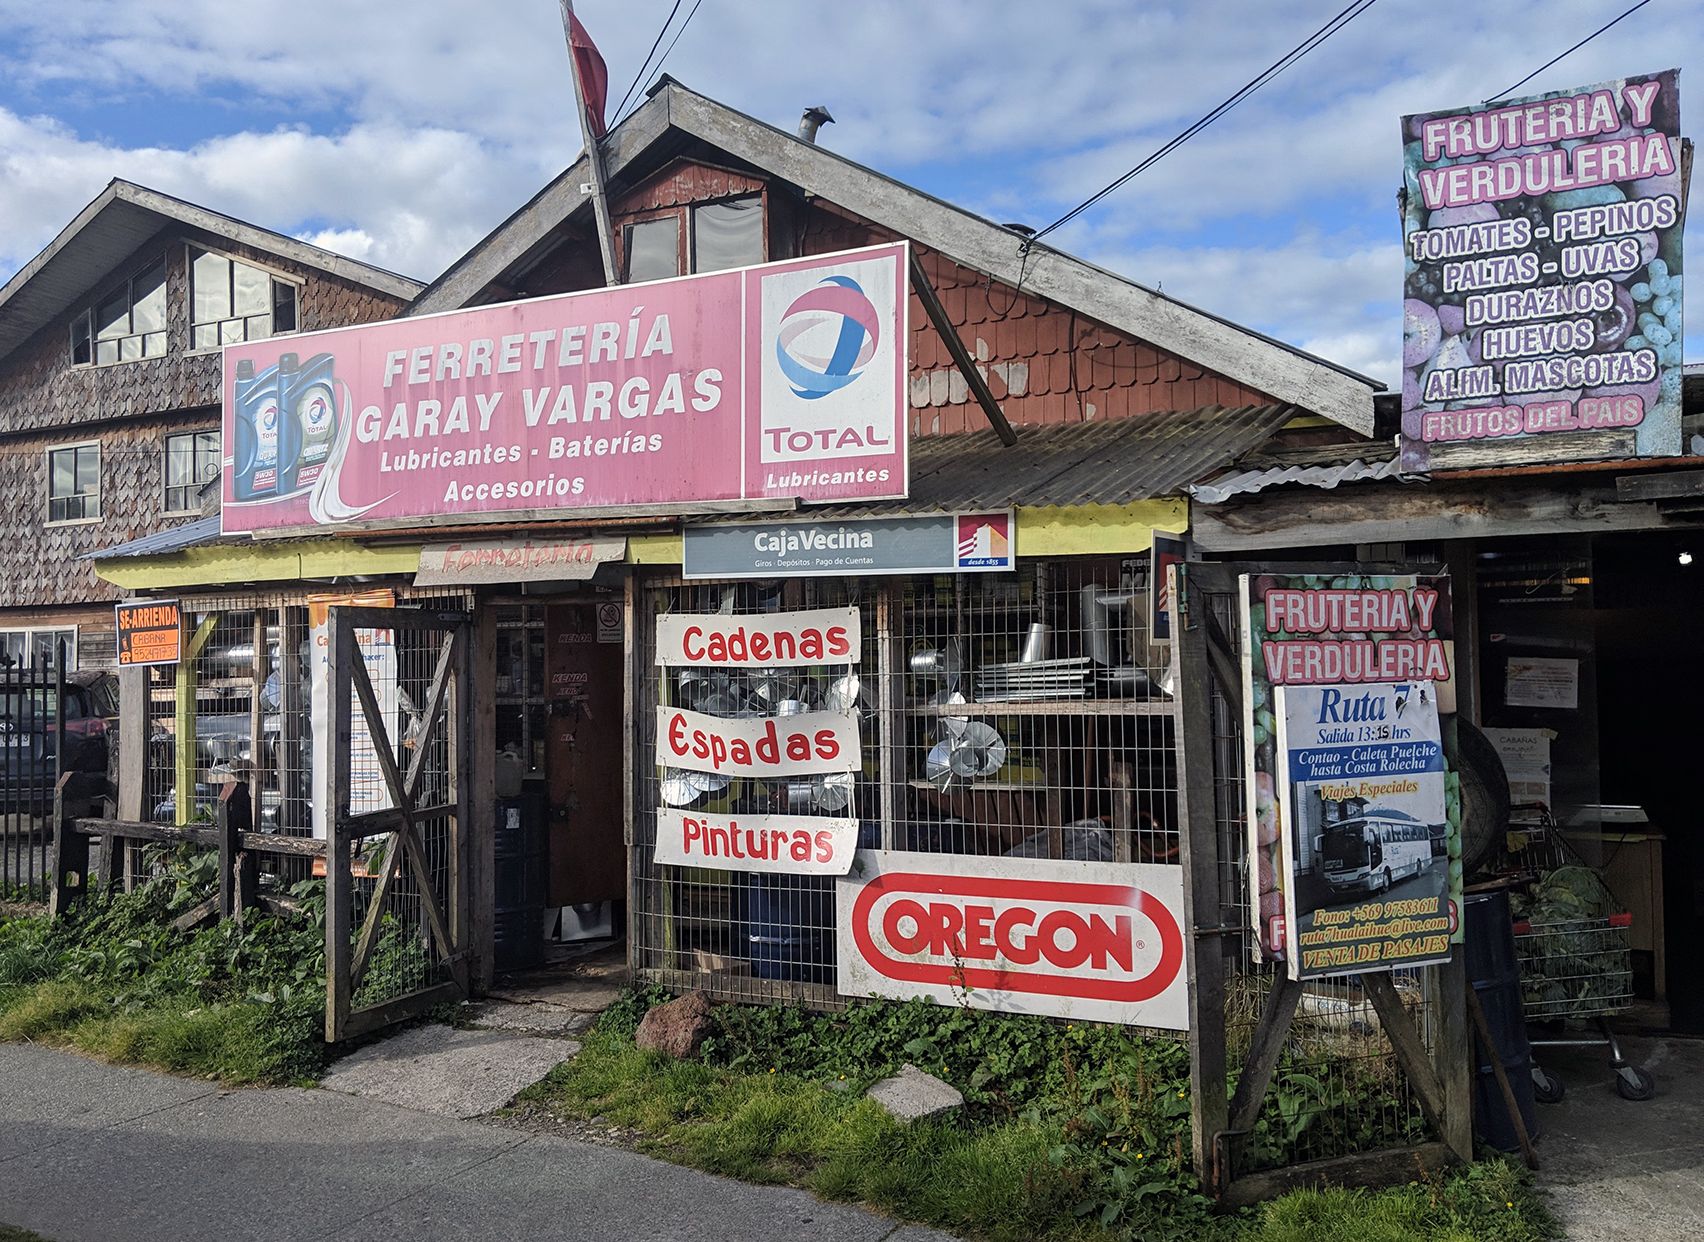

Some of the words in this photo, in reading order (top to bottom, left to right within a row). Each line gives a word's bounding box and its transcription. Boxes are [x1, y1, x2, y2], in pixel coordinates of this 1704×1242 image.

[1424, 92, 1618, 160] FRUTERIA
[1626, 84, 1657, 125] Y
[1421, 136, 1671, 207] VERDULERIA
[1411, 219, 1531, 260] TOMATES
[1555, 198, 1676, 240] PEPINOS
[1444, 255, 1538, 290] PALTAS
[1563, 241, 1638, 277] UVAS
[1467, 281, 1613, 325] DURAZNOS
[382, 306, 675, 389] FERRETERÍA
[1484, 320, 1594, 359] HUEVOS
[1506, 351, 1656, 394] MASCOTAS
[355, 391, 503, 444] GARAY
[523, 368, 724, 427] VARGAS
[1424, 407, 1523, 438] FRUTOS
[1527, 404, 1574, 430] DEL
[1581, 397, 1640, 425] PAIS
[380, 442, 522, 473] Lubricantes
[548, 431, 664, 460] Baterías
[764, 425, 890, 453] TOTAL
[443, 473, 586, 502] Accesorios
[766, 467, 890, 489] Lubricantes
[754, 559, 772, 568] Giros
[815, 558, 834, 569] Pago
[834, 557, 844, 565] de
[845, 556, 874, 566] Cuentas
[968, 558, 985, 566] desde
[1267, 592, 1409, 630] FRUTERIA
[1415, 592, 1437, 629] Y
[682, 626, 851, 662] Cadenas
[1264, 643, 1447, 681] VERDULERIA
[552, 672, 588, 684] KENDA
[1316, 688, 1387, 724] Ruta
[1394, 685, 1412, 719] 7
[668, 713, 840, 769] Espadas
[1317, 727, 1354, 744] Salida
[1391, 725, 1412, 740] hrs
[1299, 751, 1341, 765] Contao
[1351, 748, 1387, 761] Caleta
[1390, 744, 1437, 759] Puelche
[1310, 764, 1341, 777] hasta
[1345, 761, 1376, 774] Costa
[1380, 757, 1426, 772] Rolecha
[1320, 785, 1357, 802] Viajes
[1359, 780, 1419, 799] Especiales
[683, 816, 834, 864] Pinturas
[1313, 909, 1351, 926] Fono:
[1352, 904, 1383, 920] +569
[882, 899, 1134, 973] OREGON
[1303, 946, 1355, 969] VENTA
[1357, 943, 1380, 961] DE
[1383, 935, 1449, 959] PASAJES
